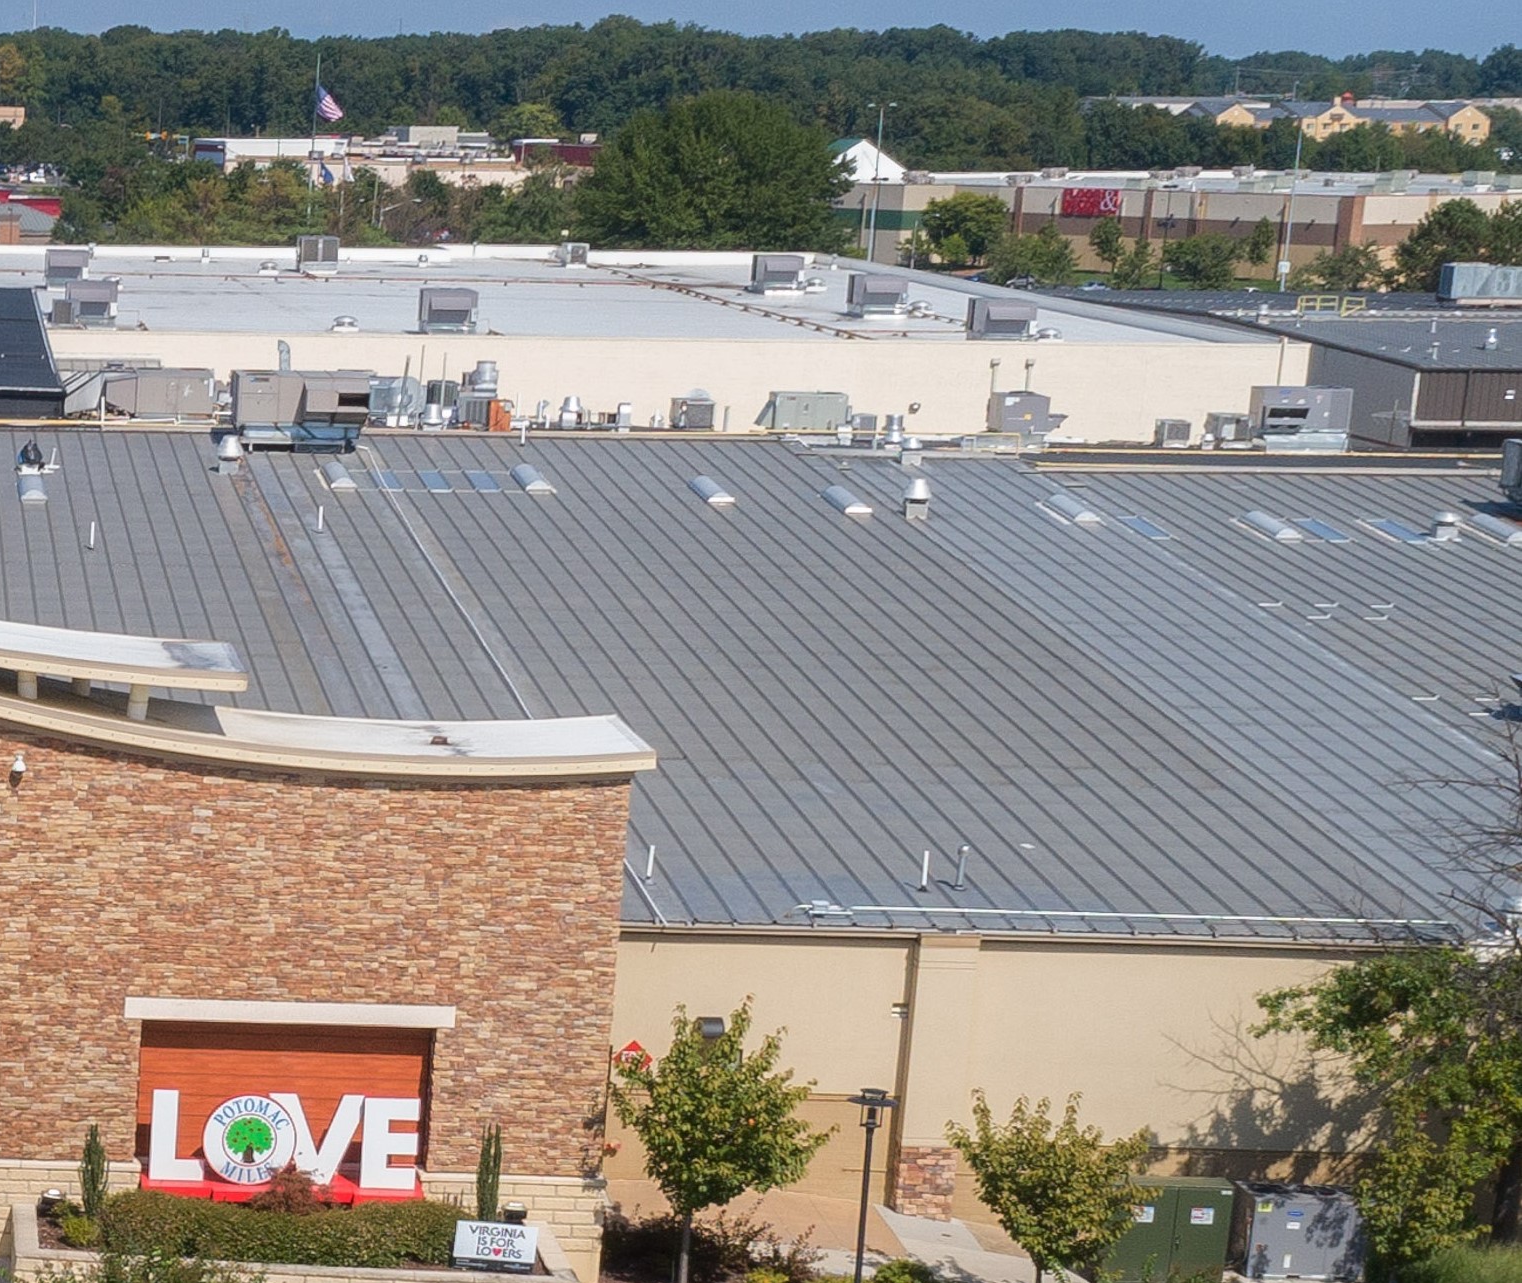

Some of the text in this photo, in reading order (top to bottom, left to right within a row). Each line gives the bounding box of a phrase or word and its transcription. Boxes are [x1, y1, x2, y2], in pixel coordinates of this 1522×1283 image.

[213, 1097, 290, 1130] POTOMAC
[149, 1089, 421, 1190] LOVE
[469, 1224, 526, 1240] VIRGINIA
[477, 1235, 517, 1249] IS FOR
